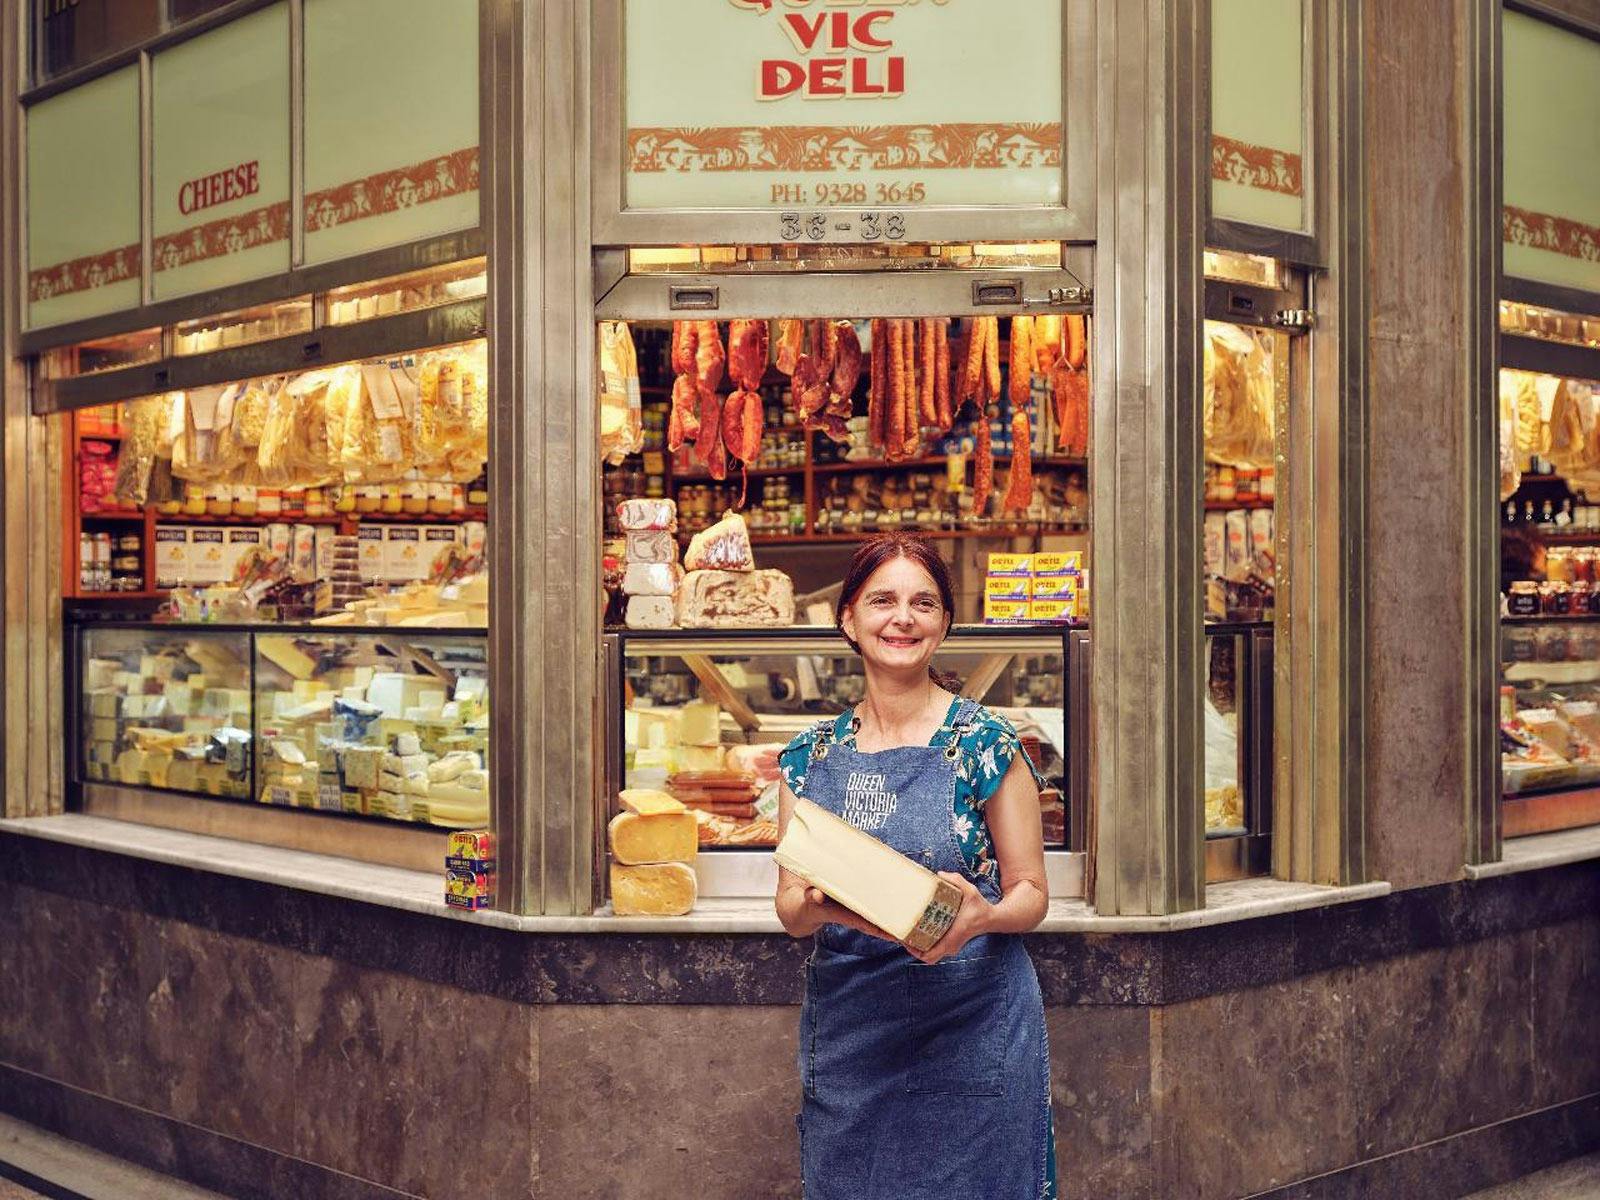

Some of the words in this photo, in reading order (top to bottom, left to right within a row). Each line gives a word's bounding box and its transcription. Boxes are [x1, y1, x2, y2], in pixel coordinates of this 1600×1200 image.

[782, 10, 894, 51] VIC
[759, 56, 905, 99] DELI
[178, 159, 260, 216] CHEESE
[771, 183, 807, 204] PH:
[815, 182, 868, 205] 9328
[875, 181, 927, 205] 3645
[847, 772, 886, 792] QUEEN
[844, 790, 897, 814] VICTORIA
[841, 812, 889, 831] MARKET
